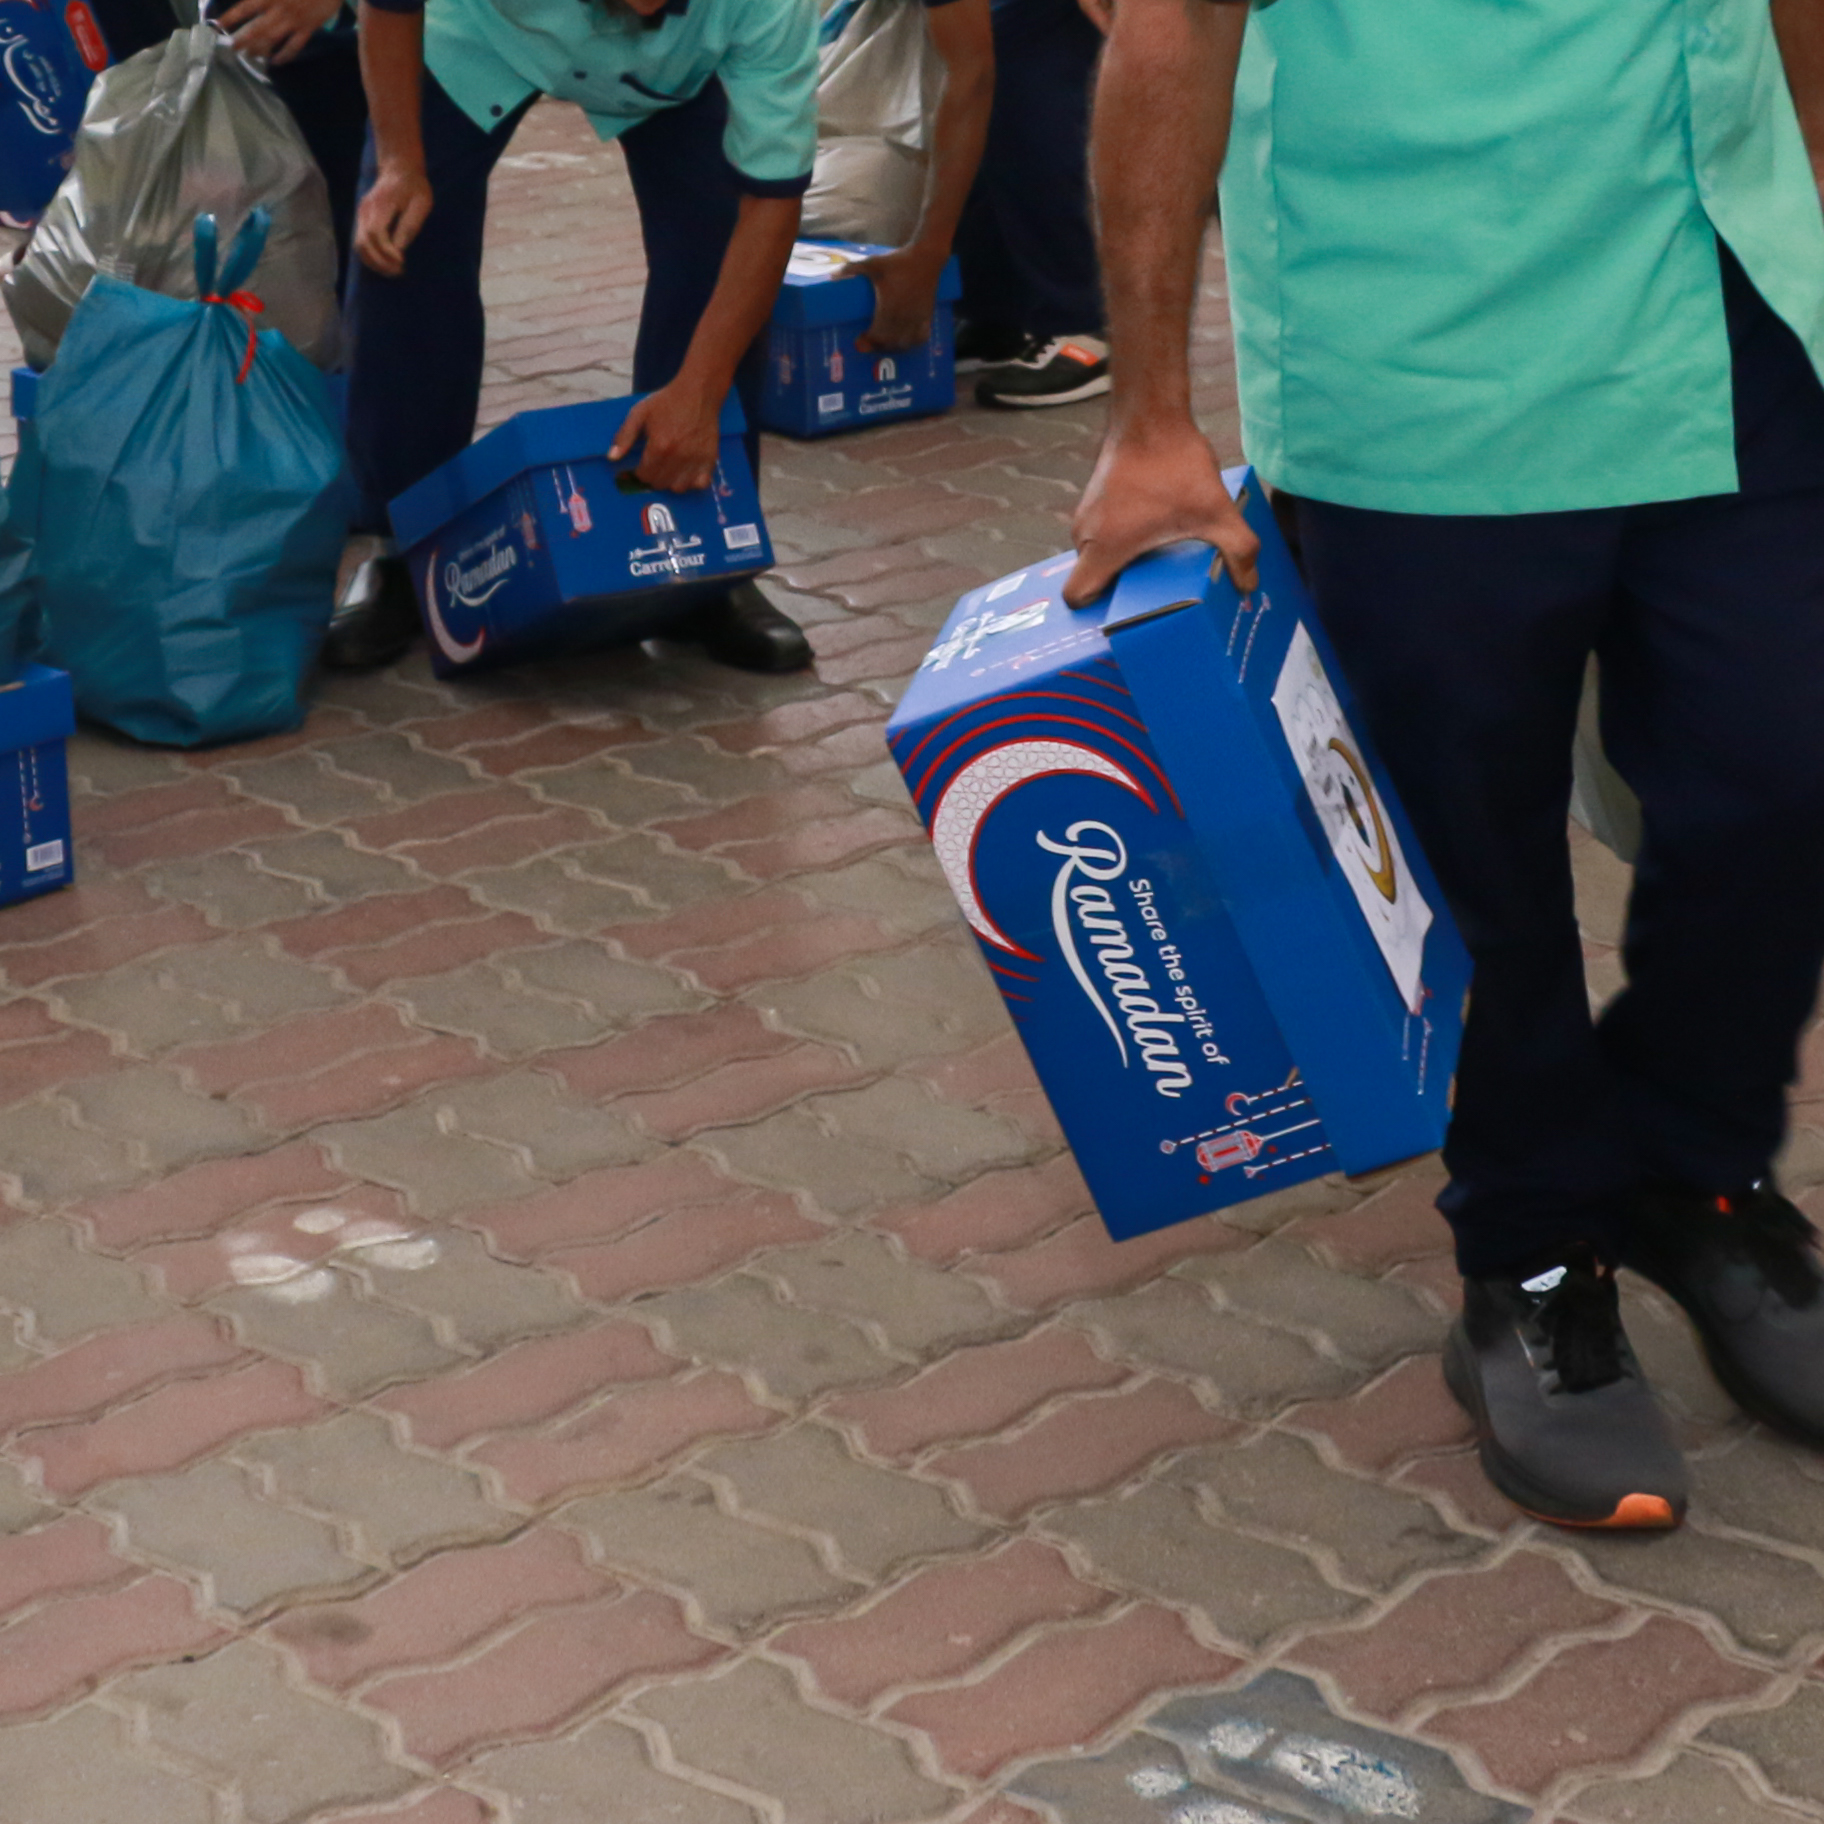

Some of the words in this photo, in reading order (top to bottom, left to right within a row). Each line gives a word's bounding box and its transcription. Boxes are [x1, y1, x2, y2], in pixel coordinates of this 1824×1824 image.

[1035, 819, 1193, 1098] Ramadan
[1128, 878, 1168, 942] Share
[1158, 943, 1186, 981] the
[1175, 984, 1214, 1039] spirit
[1202, 1042, 1231, 1065] of
